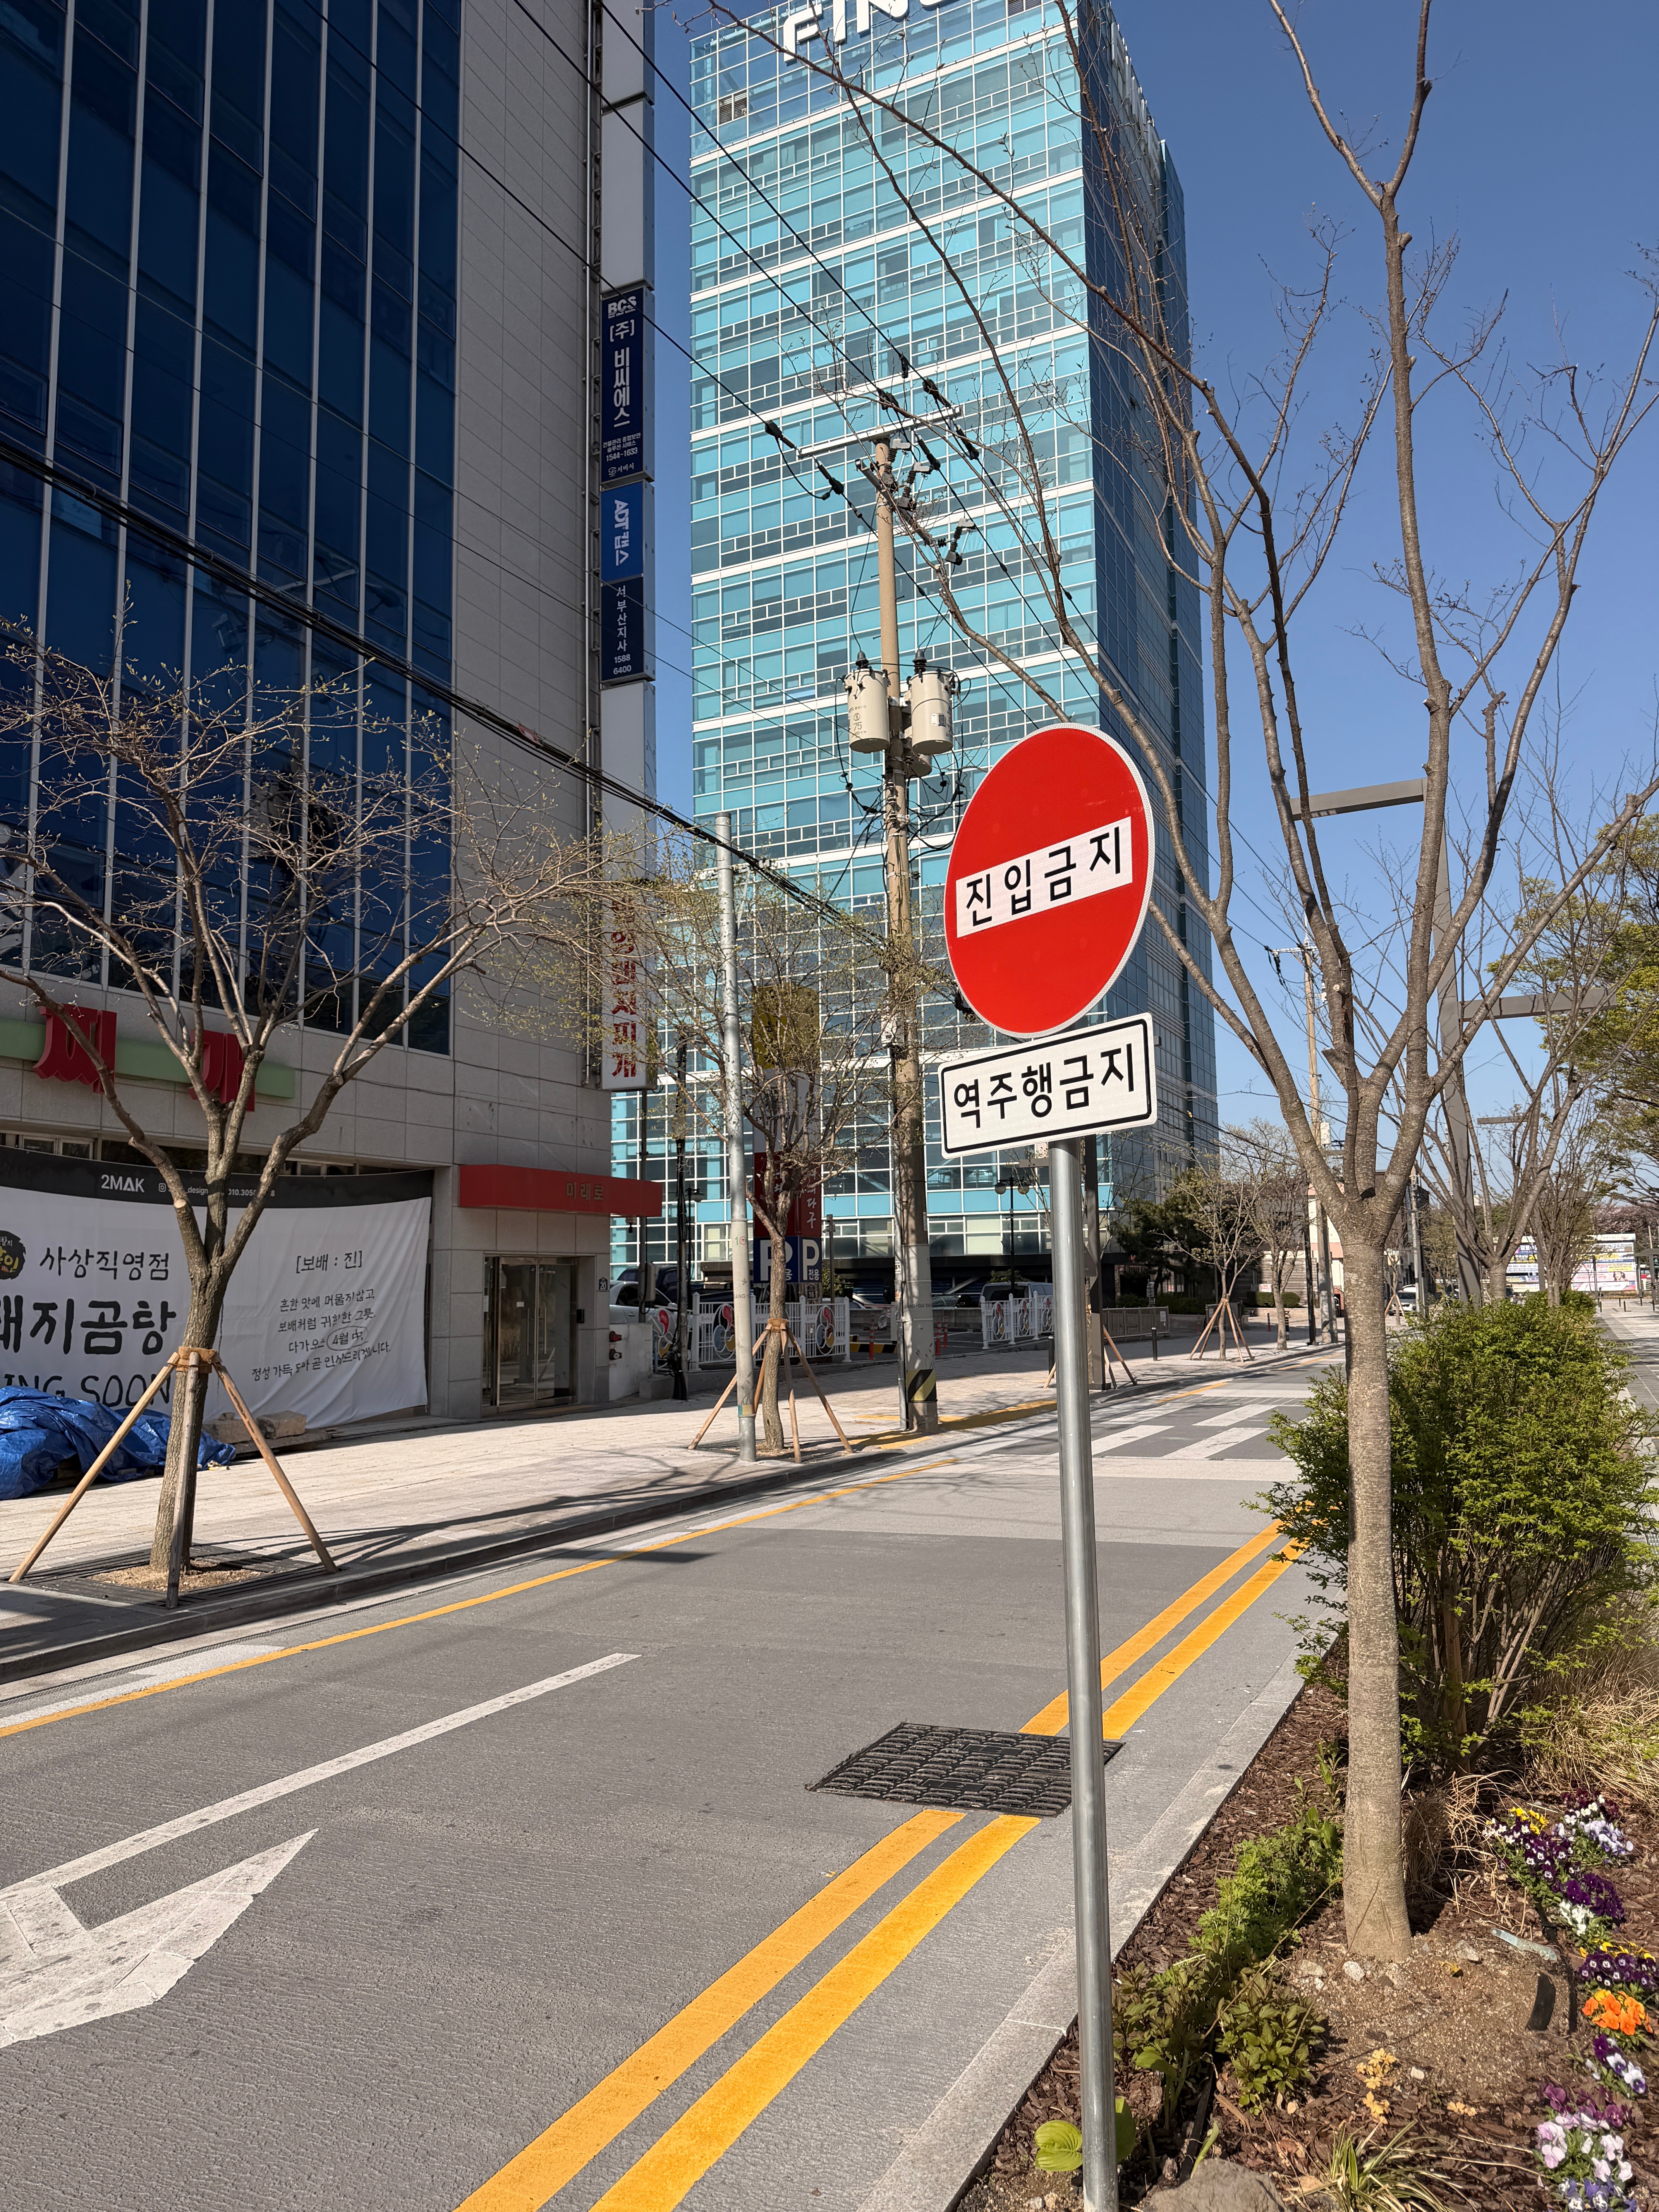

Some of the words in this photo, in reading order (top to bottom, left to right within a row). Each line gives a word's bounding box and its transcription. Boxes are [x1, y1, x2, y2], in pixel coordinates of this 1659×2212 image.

[783, 0, 960, 62] FIN
[608, 296, 637, 316] BCS
[613, 347, 630, 428] 비씨에스
[606, 447, 638, 462] 1544-1633
[616, 585, 627, 652] 서부산지사
[614, 654, 631, 663] 1588
[613, 665, 632, 675] 6400
[853, 722, 862, 731] 75
[966, 826, 1121, 927] 진입금지
[954, 1043, 1135, 1129] 역주행금지
[101, 1174, 145, 1193] 2MAK
[566, 1182, 603, 1200] 미래로
[40, 1246, 169, 1281] 사상직영점
[296, 1254, 329, 1273] [보배
[344, 1250, 362, 1269] 진]
[760, 1240, 793, 1281] P
[802, 1239, 819, 1280] P
[808, 1269, 819, 1281] 전용
[600, 1282, 607, 1290] 20
[280, 1298, 299, 1312] 흔한
[302, 1296, 320, 1310] 맛에
[278, 1317, 316, 1333] 보배처럼
[332, 1332, 349, 1345] 4월
[252, 1367, 270, 1381] 정성
[273, 1364, 293, 1377] 가득
[312, 1357, 322, 1370] 곧
[81, 1374, 171, 1407] SOON
